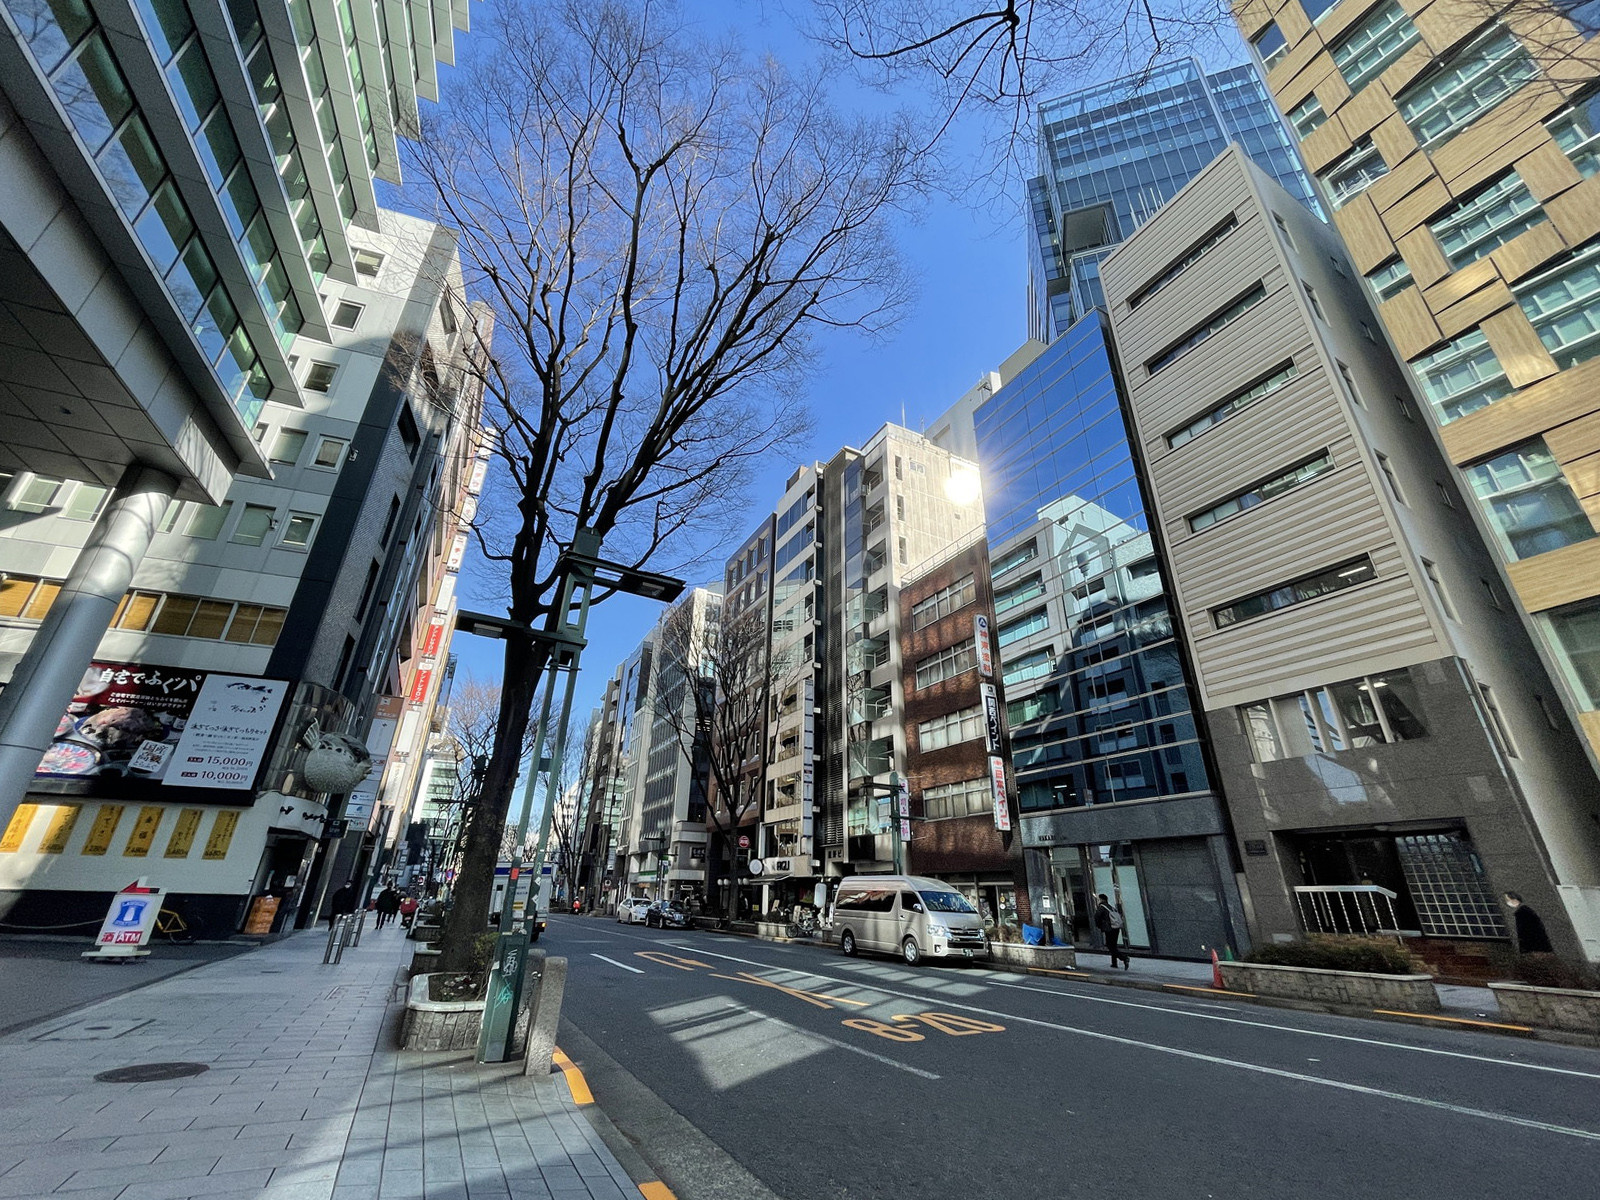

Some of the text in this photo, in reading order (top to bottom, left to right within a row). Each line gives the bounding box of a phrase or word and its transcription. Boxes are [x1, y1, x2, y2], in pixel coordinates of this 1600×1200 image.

[100, 668, 202, 694] 自宅でふぐパ
[207, 756, 253, 767] 15,000円
[201, 771, 248, 782] 10,000円
[995, 769, 1009, 828] 日本ペイント
[116, 932, 141, 942] ATM
[842, 1013, 1006, 1042] 8-20
